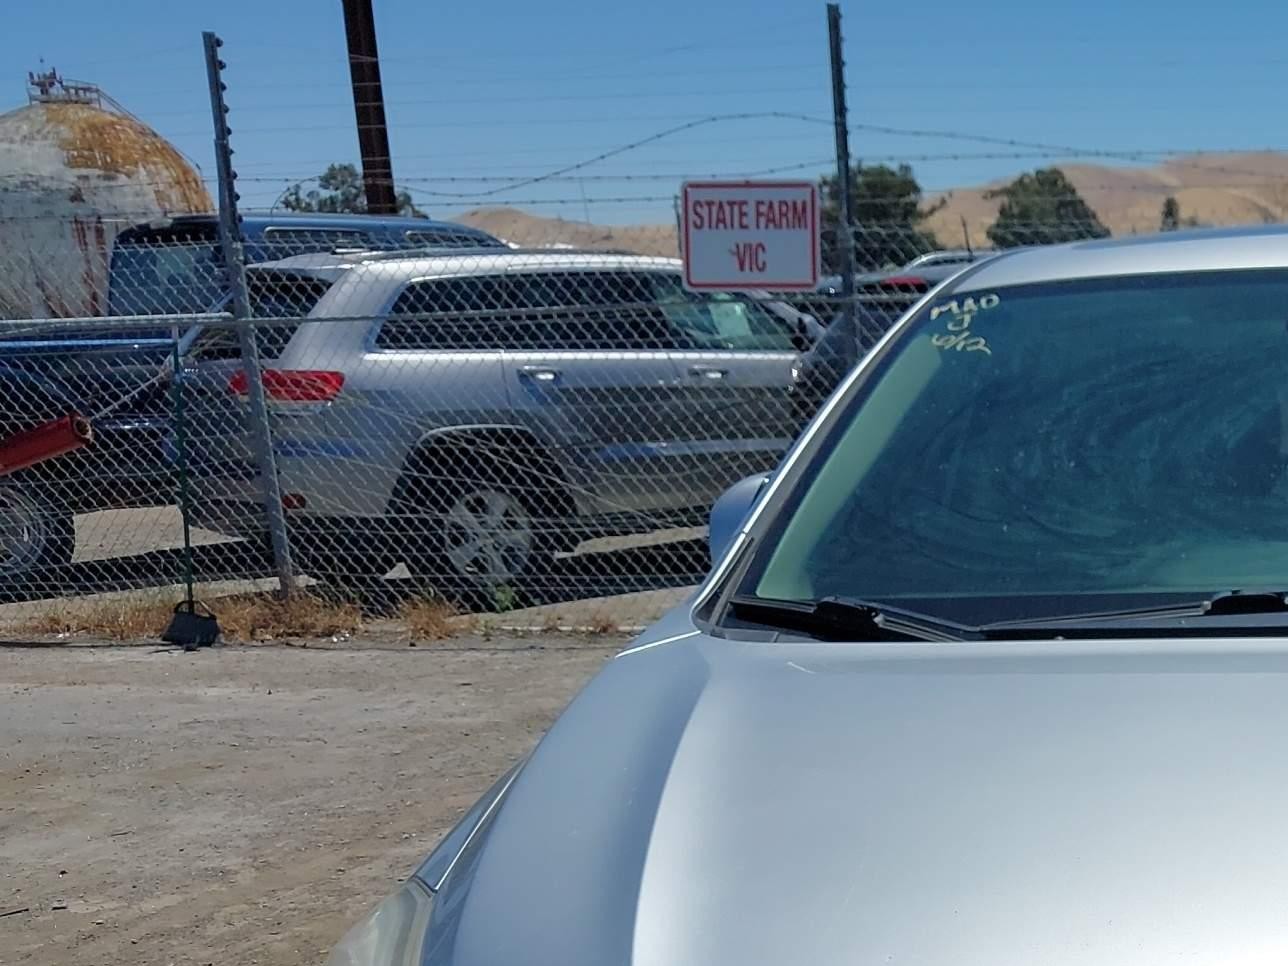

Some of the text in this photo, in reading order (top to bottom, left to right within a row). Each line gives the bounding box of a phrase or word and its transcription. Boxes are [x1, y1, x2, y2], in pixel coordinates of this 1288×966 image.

[692, 199, 808, 230] STATE FARM
[735, 242, 767, 273] VIC
